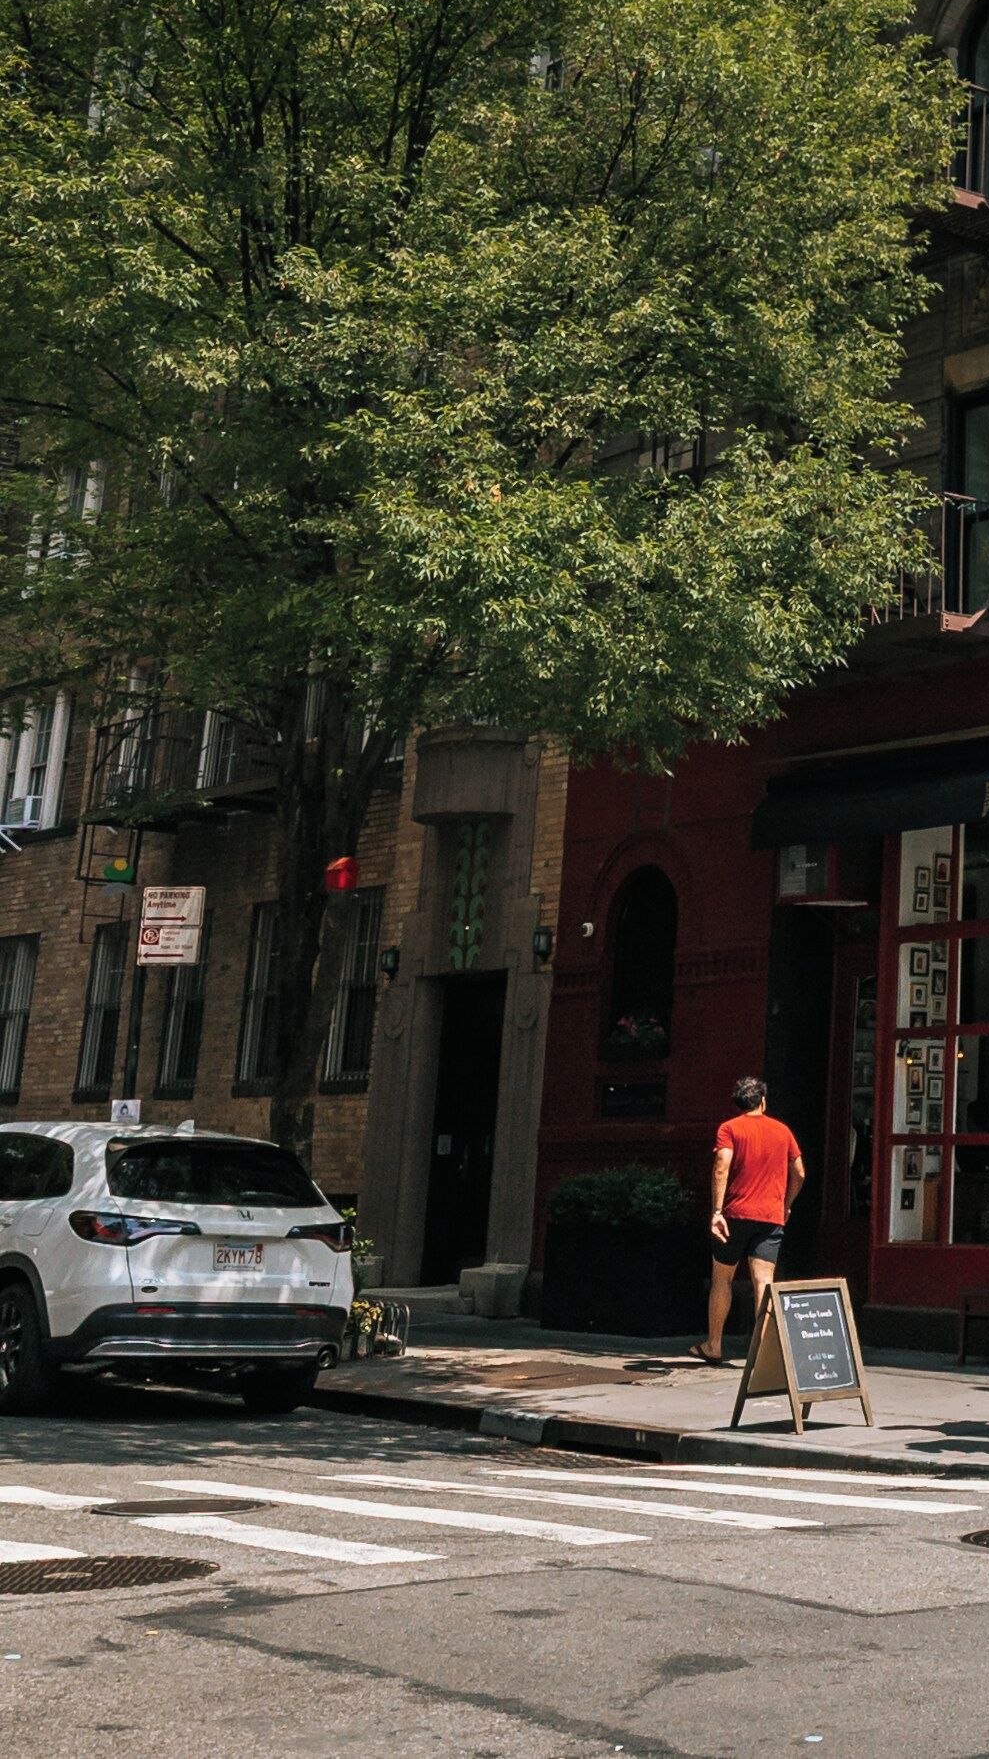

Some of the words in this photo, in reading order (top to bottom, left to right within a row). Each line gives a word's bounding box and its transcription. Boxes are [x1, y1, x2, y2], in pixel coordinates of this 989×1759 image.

[148, 891, 157, 899] NO
[160, 891, 191, 899] PARKING
[147, 901, 177, 910] Anytime
